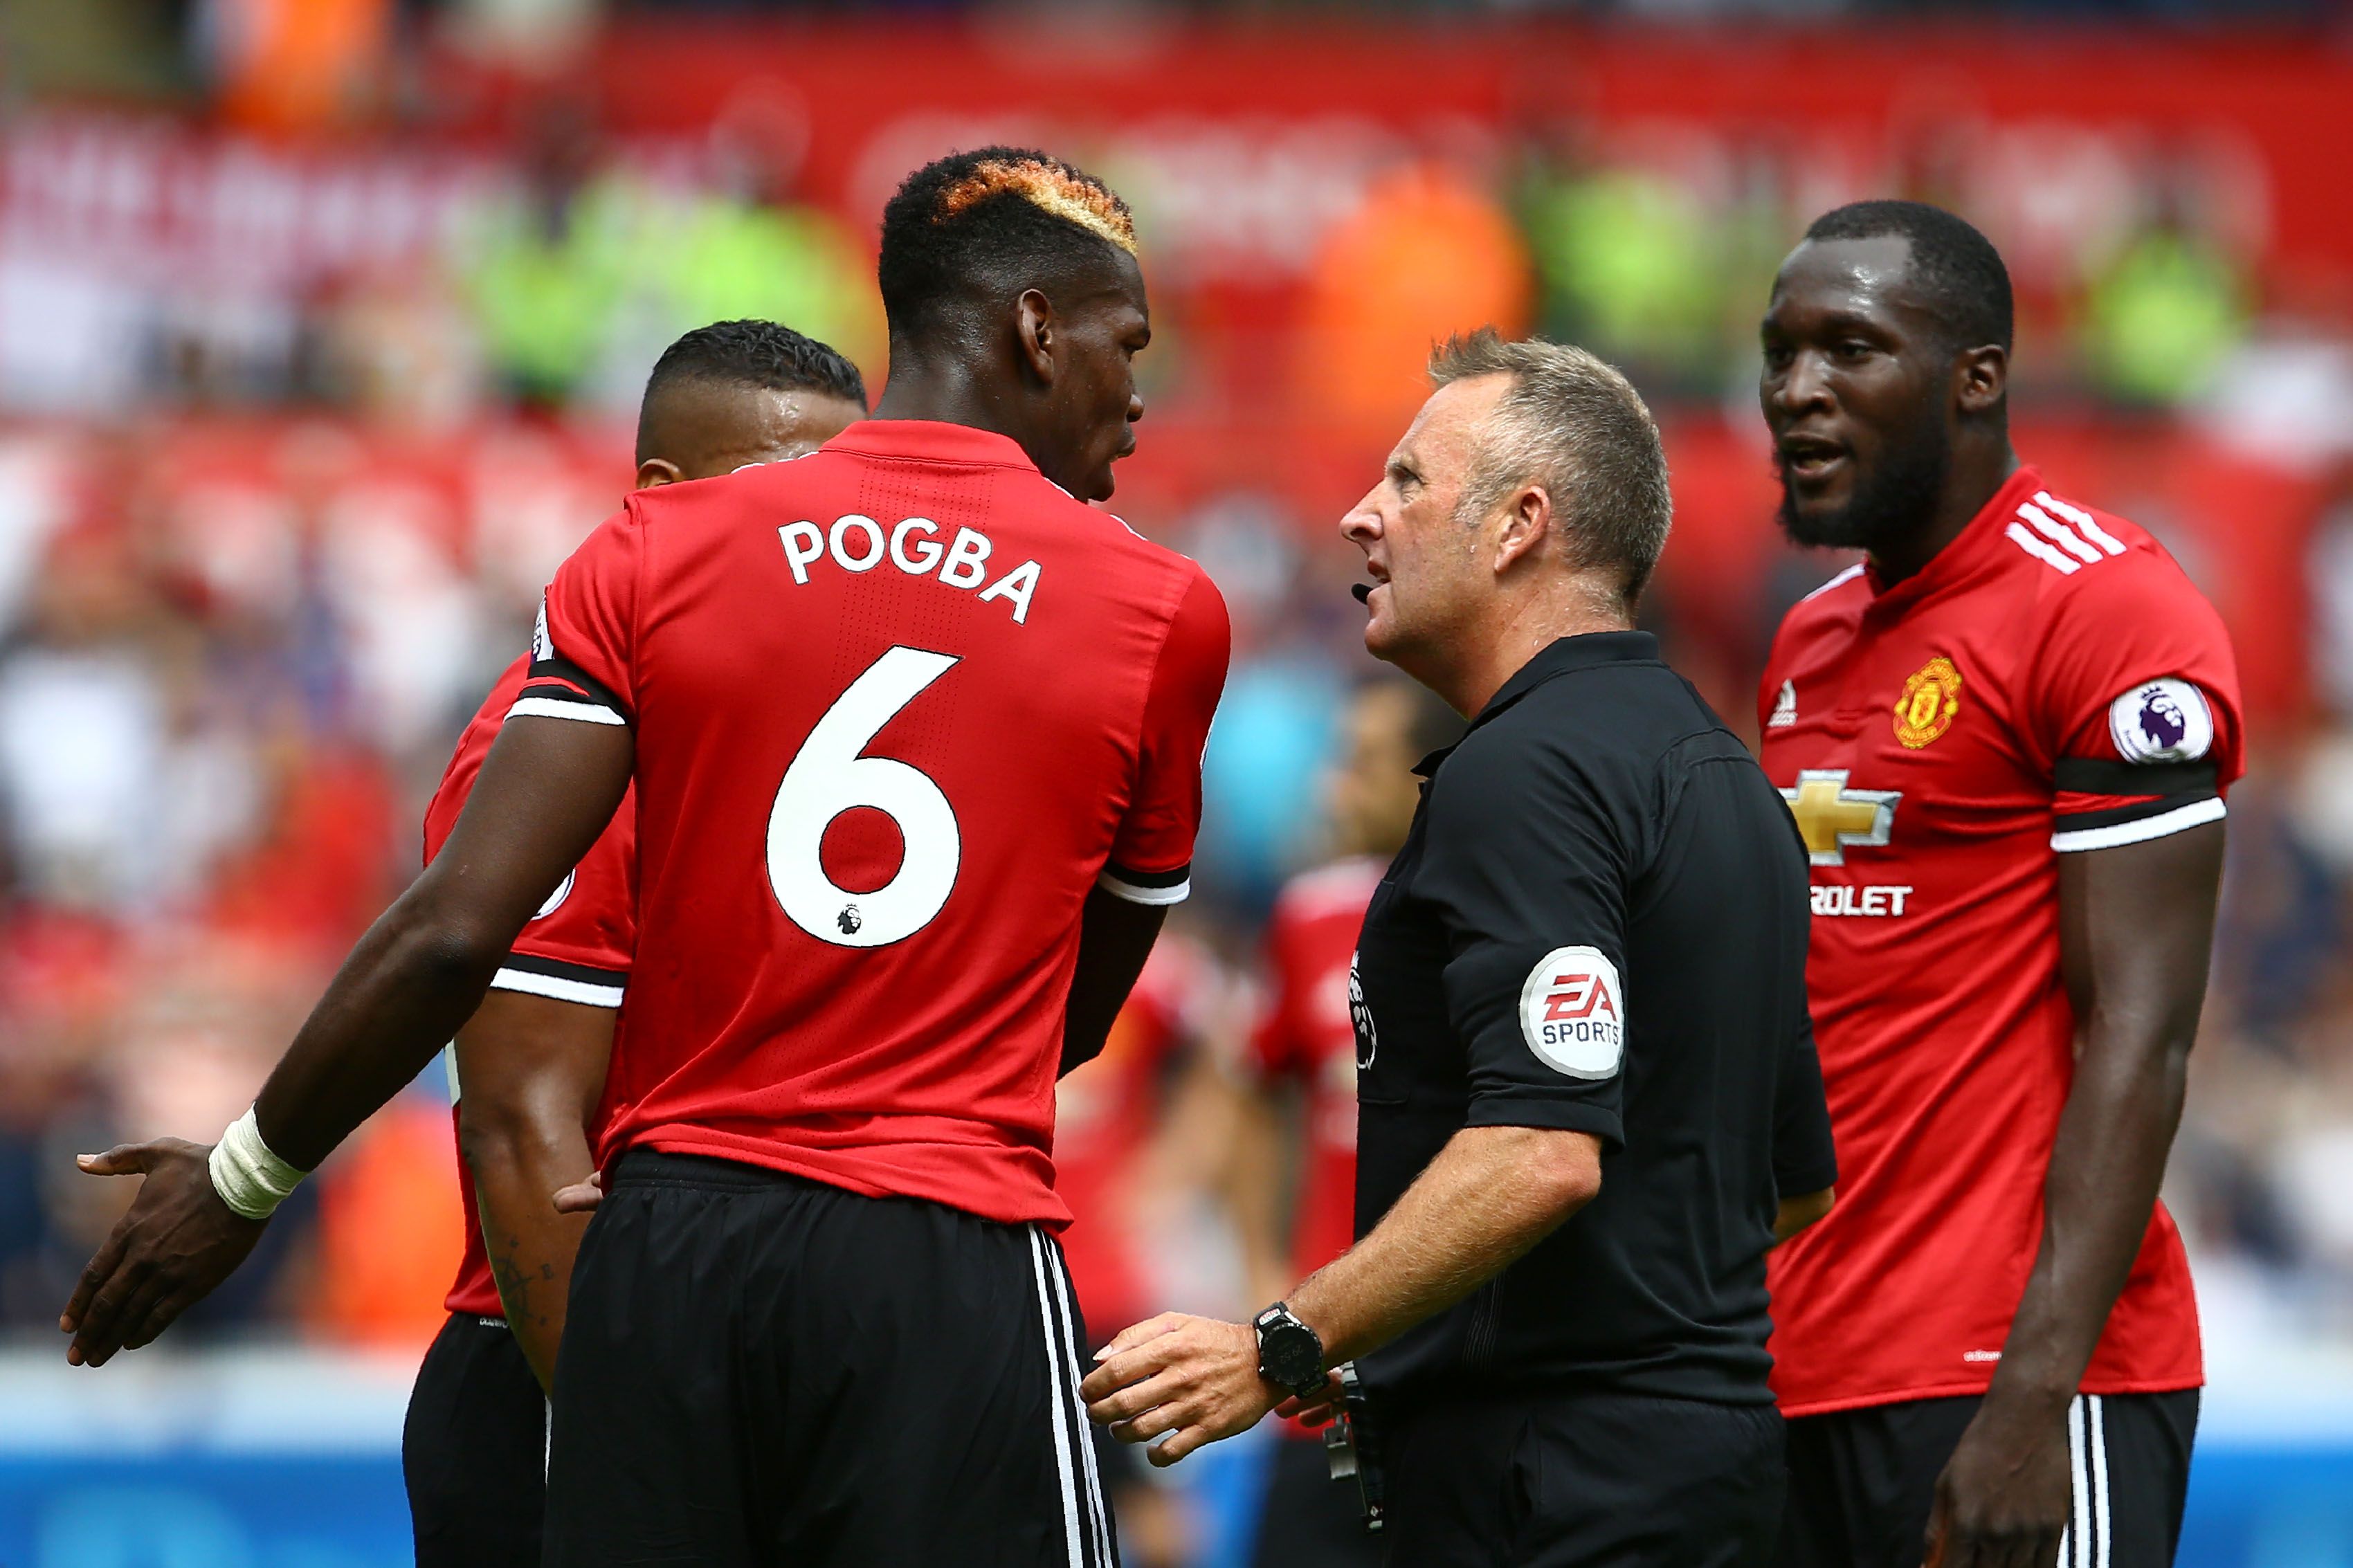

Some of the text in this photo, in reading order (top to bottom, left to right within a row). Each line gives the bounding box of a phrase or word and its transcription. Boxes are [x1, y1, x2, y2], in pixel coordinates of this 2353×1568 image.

[777, 514, 1042, 626] POGBA
[765, 644, 965, 948] 6
[1543, 973, 1618, 1022] EA
[1543, 1021, 1620, 1046] SPORTS
